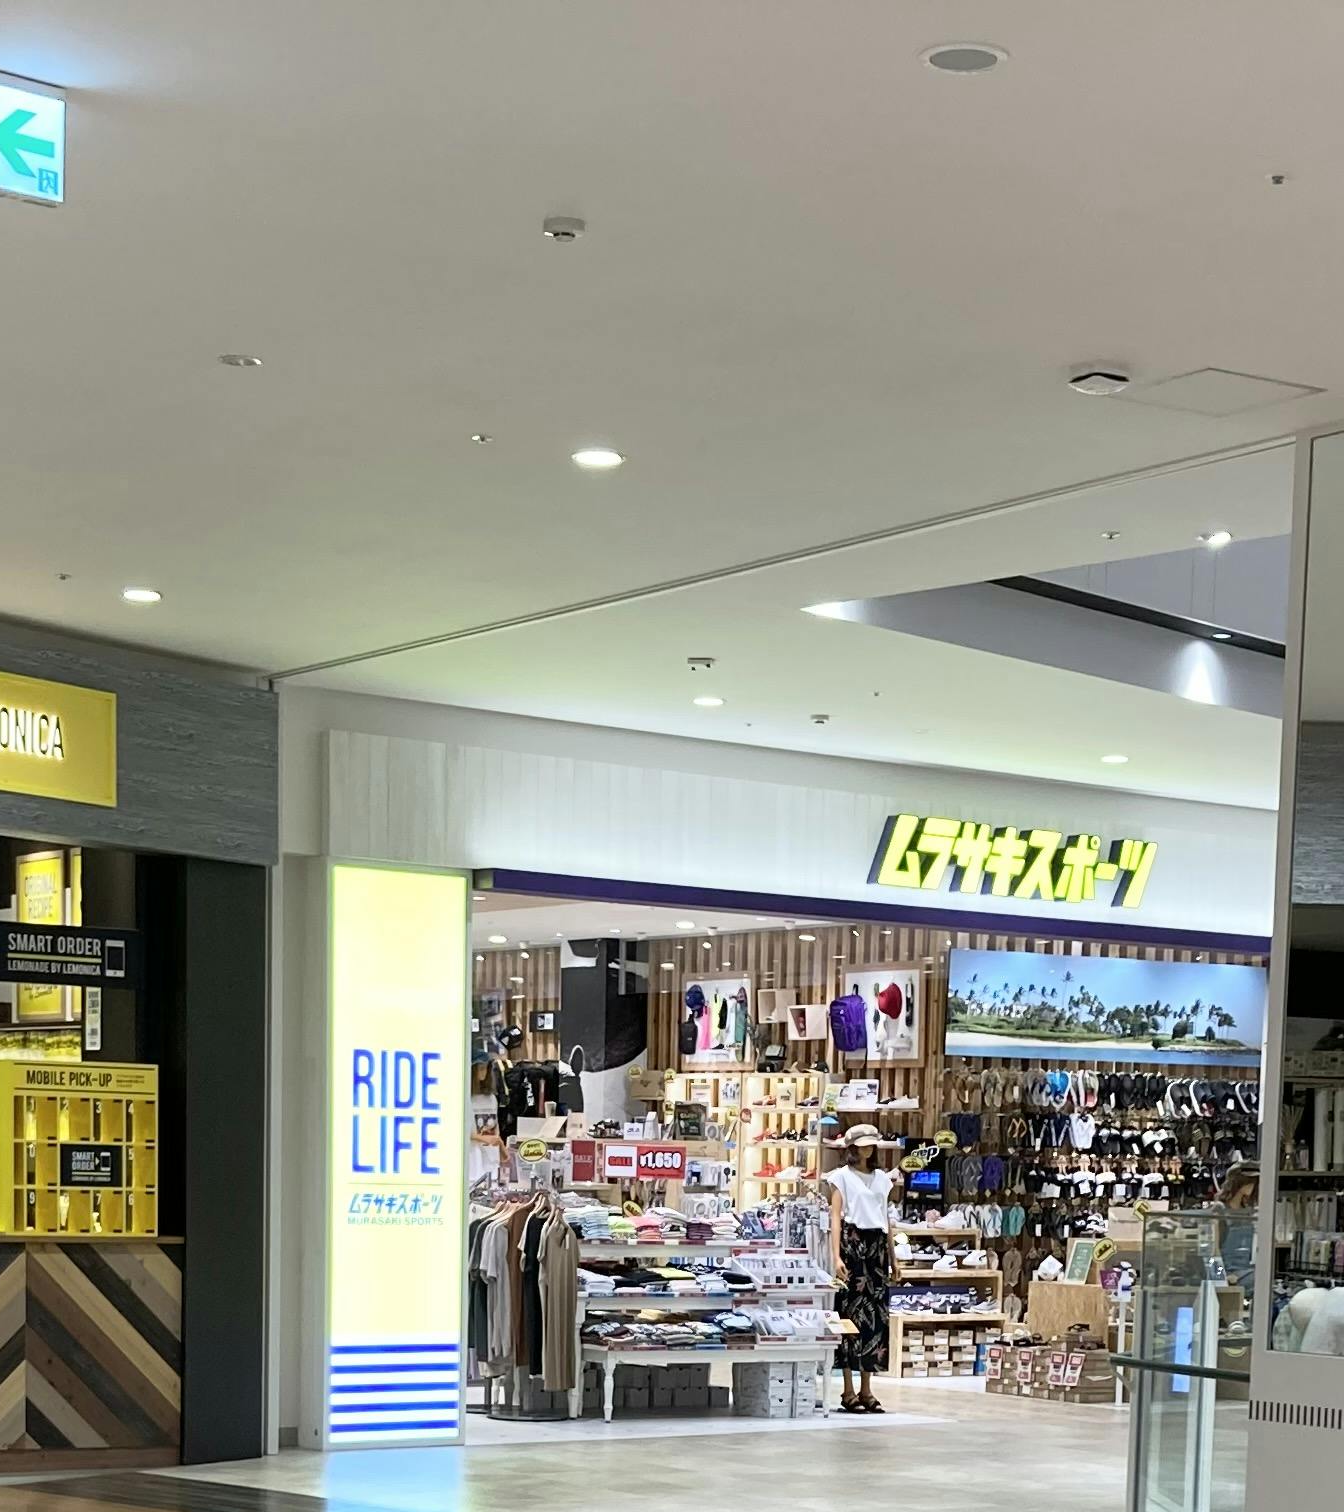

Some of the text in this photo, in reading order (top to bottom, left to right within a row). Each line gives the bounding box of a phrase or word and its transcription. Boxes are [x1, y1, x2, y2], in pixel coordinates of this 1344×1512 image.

[870, 814, 1157, 908] ムラサキスポーツ
[8, 932, 102, 956] SMART ORDER
[7, 959, 102, 976] LEMONADE BY LEMONICA
[26, 1069, 66, 1086] MOBILE
[69, 1071, 112, 1088] PICK-UP
[352, 1049, 442, 1111] RIDE
[352, 1115, 442, 1174] LIFE
[72, 1151, 95, 1162] SMART
[72, 1161, 96, 1171] ORDER
[639, 1151, 682, 1168] ¥1,650
[348, 1192, 444, 1214] ムラサキスポーツ
[347, 1216, 444, 1226] MURASAKI SPORTS
